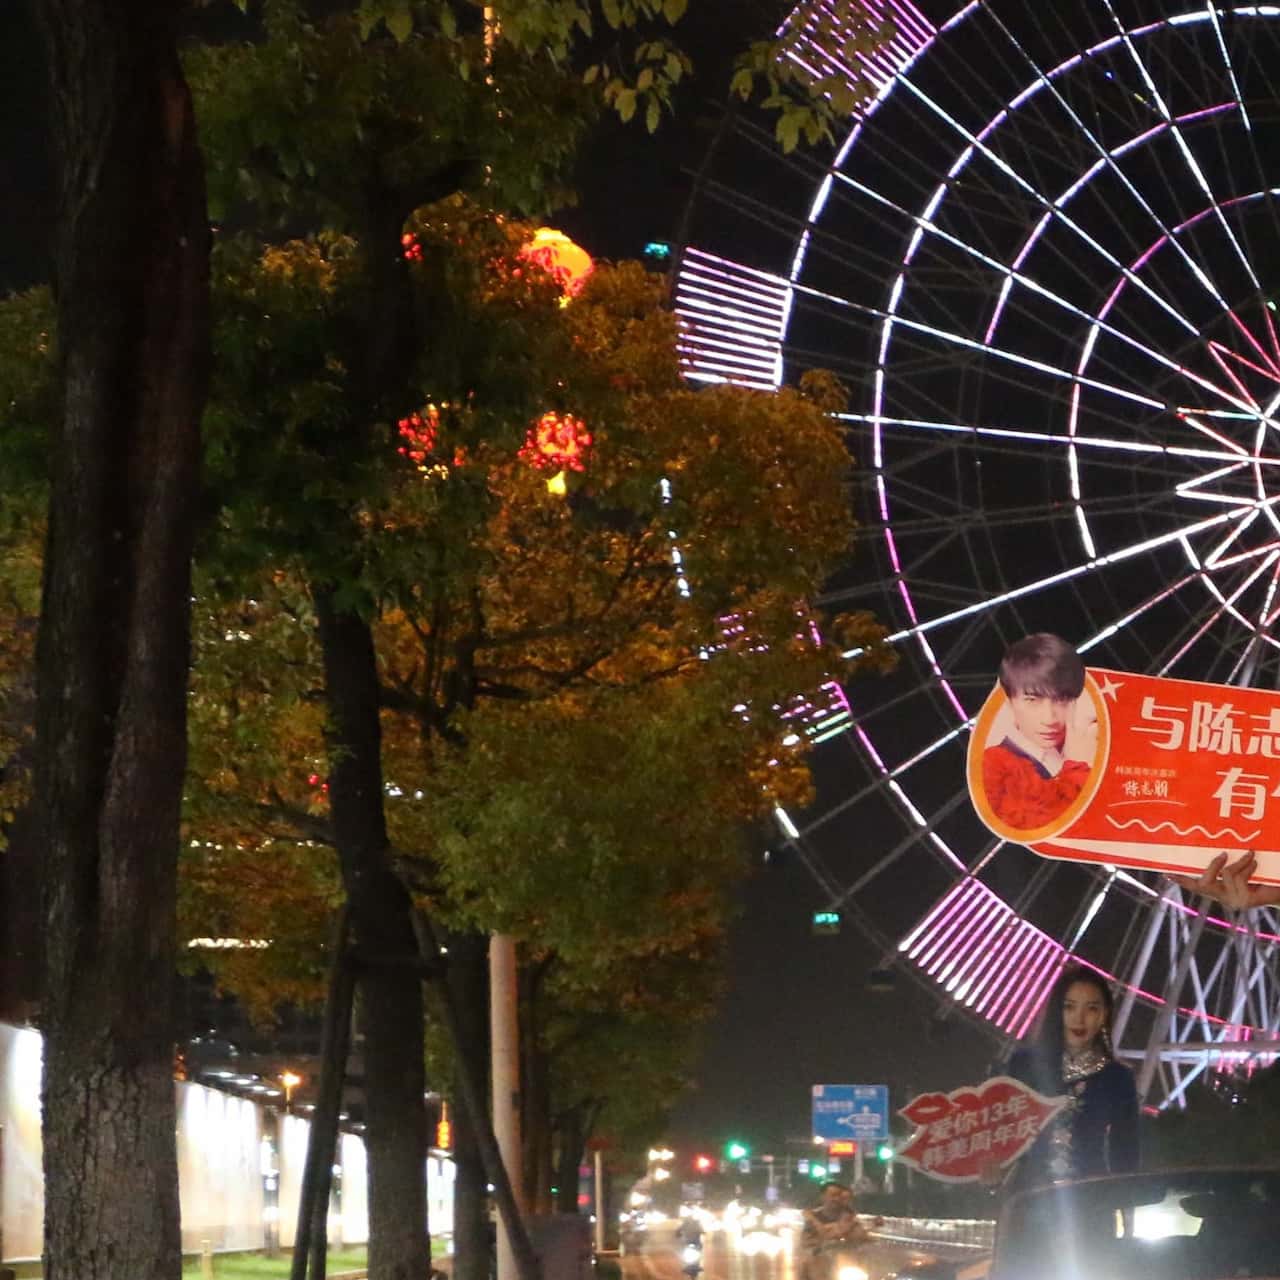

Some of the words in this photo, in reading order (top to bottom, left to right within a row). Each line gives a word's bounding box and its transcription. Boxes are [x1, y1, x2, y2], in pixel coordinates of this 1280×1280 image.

[921, 1115, 1041, 1169] 韩美周年庆
[928, 1094, 1030, 1144] 爱你13年
